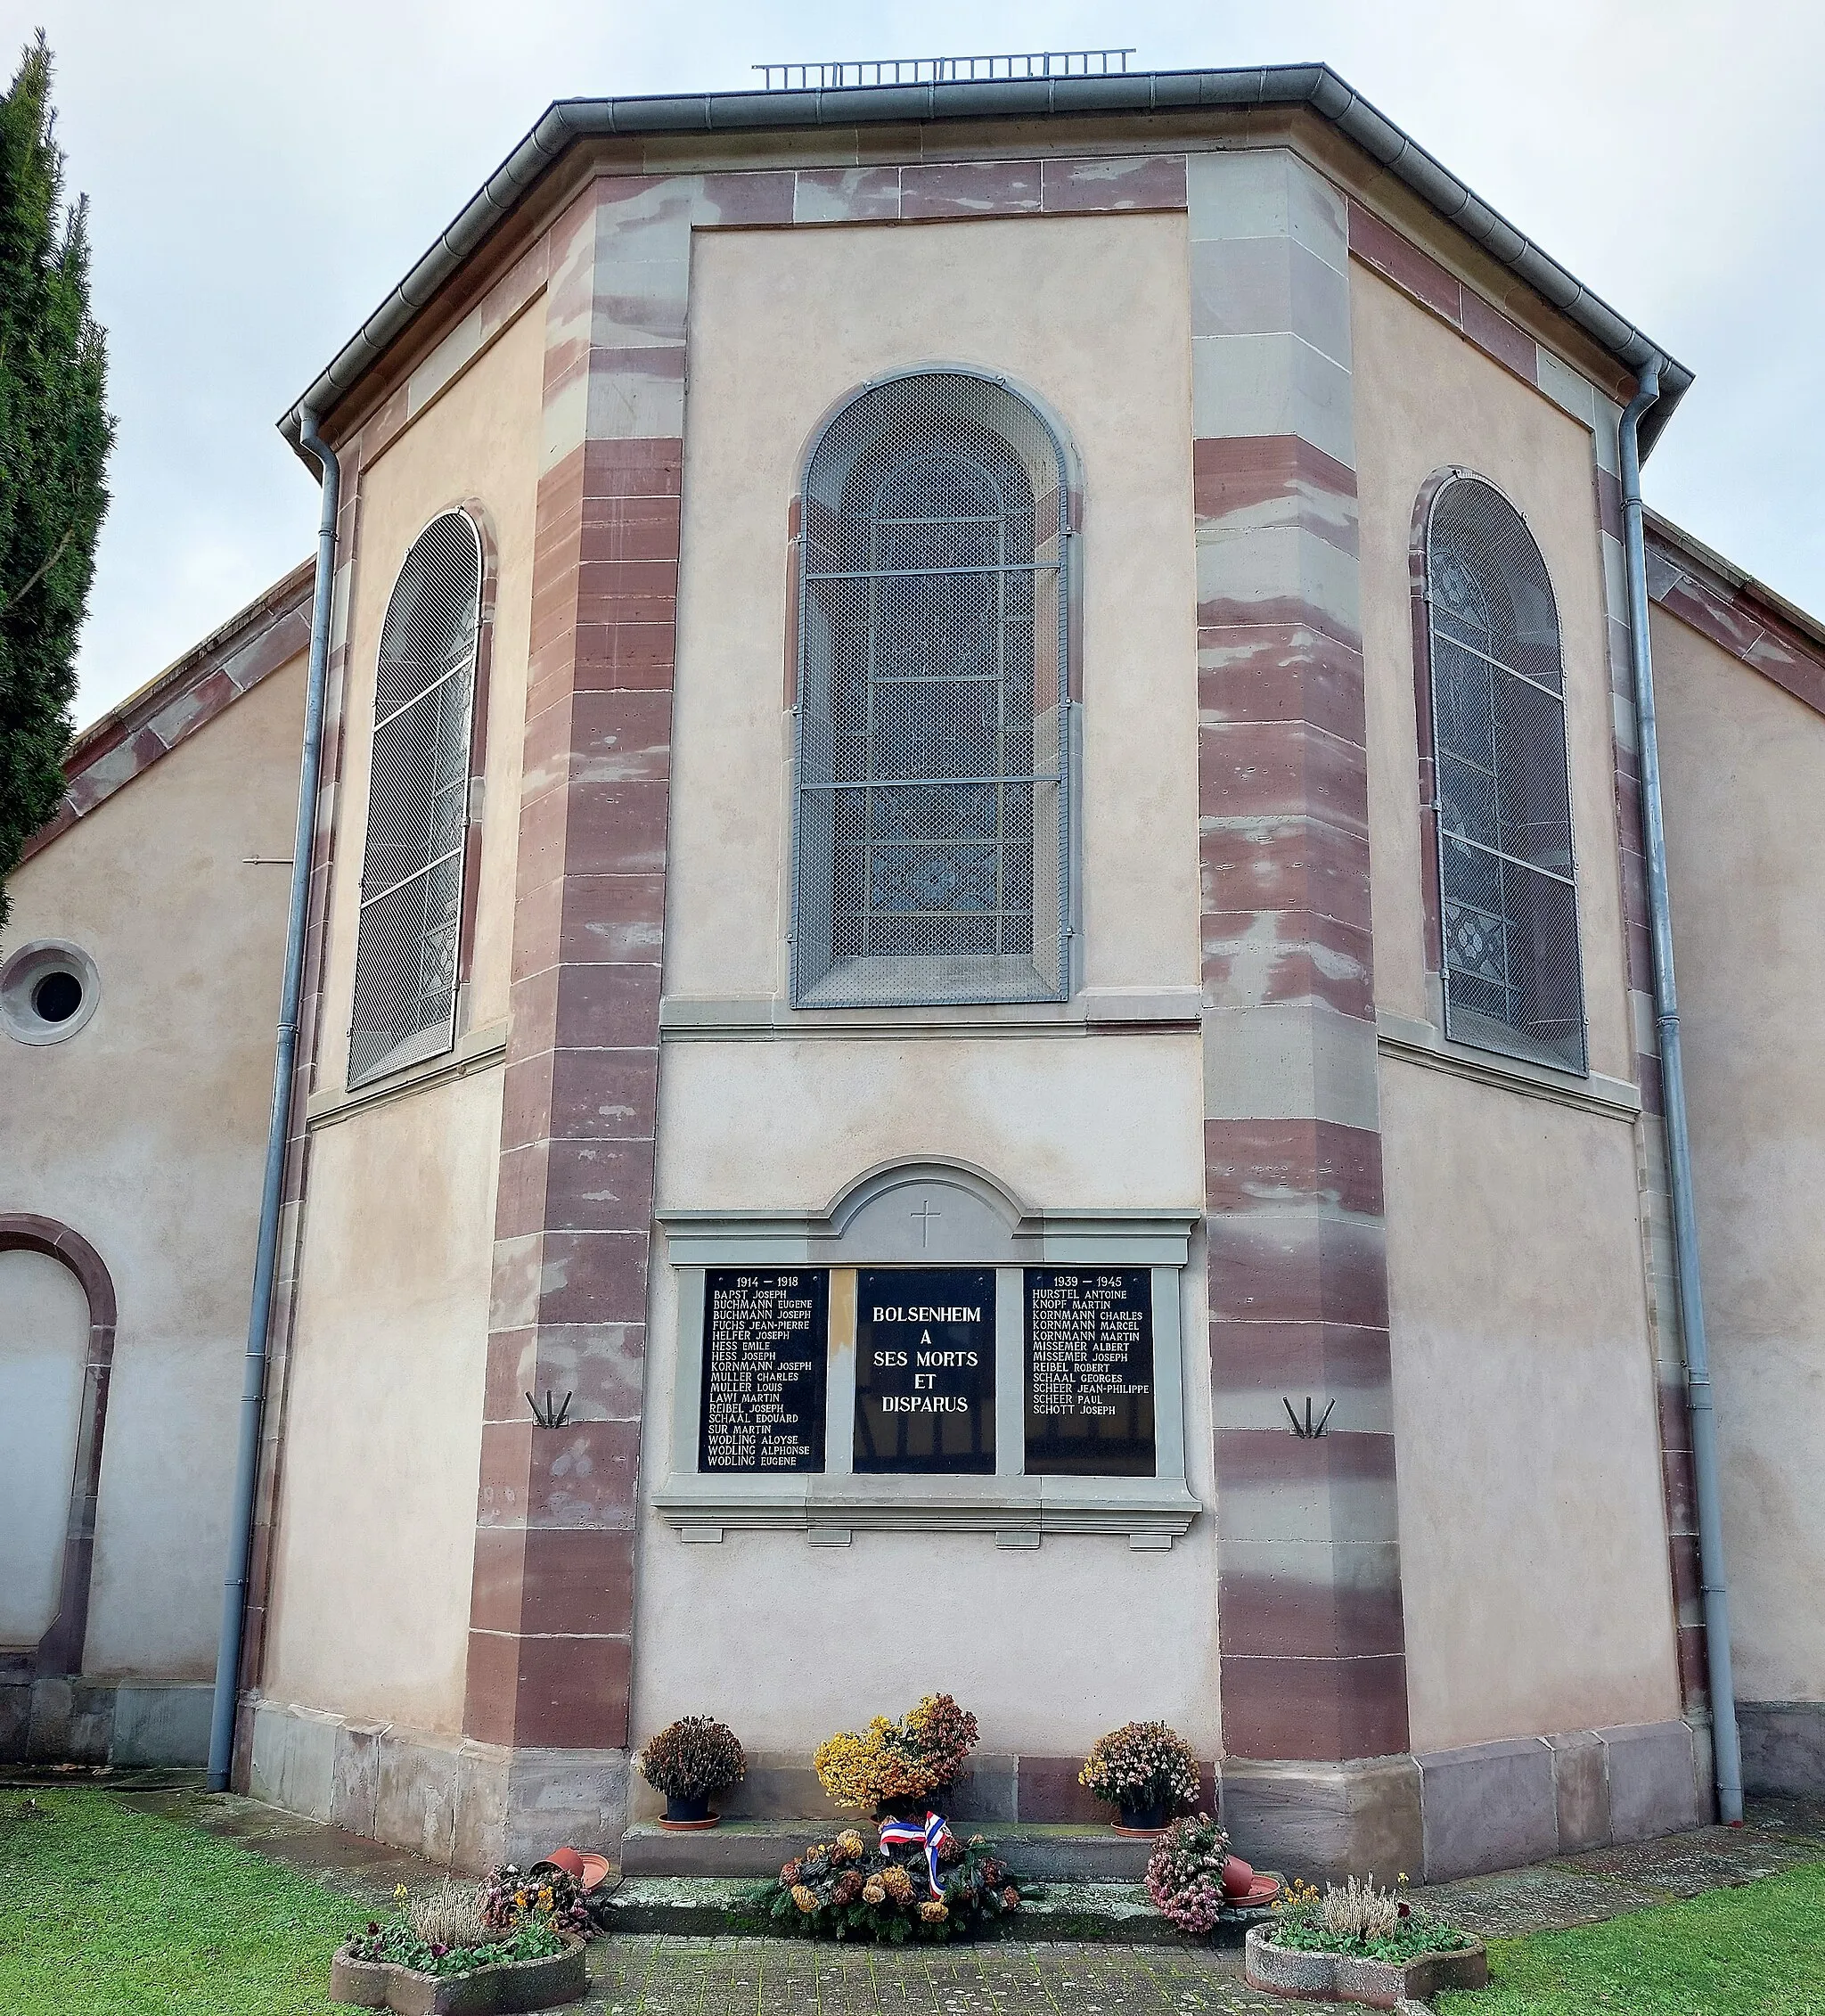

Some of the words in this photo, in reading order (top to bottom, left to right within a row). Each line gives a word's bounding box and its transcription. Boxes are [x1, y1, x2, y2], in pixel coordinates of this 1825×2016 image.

[737, 1276, 759, 1288] 1914
[777, 1276, 798, 1287] 1918
[1054, 1276, 1078, 1287] 1939
[1097, 1276, 1122, 1287] 1945
[714, 1290, 749, 1299] BAPST
[753, 1291, 787, 1299] JOSEPH
[1032, 1289, 1080, 1299] HURSTEL
[1084, 1290, 1127, 1299] ANTOINE
[713, 1299, 773, 1309] BUCHMANN
[778, 1300, 813, 1309] EUGENE
[1032, 1299, 1067, 1309] KNOPF
[1072, 1300, 1111, 1309] MARTIN
[713, 1310, 773, 1320] BUCHMANN
[777, 1310, 812, 1319] JOSEPH
[872, 1307, 981, 1323] BOLSENHEIM
[1032, 1310, 1095, 1320] KORNMANN
[1100, 1311, 1142, 1320] CHARLES
[713, 1321, 745, 1331] FUCHS
[749, 1321, 810, 1330] JEAN-PIERRE
[1032, 1320, 1095, 1331] KORNMANN
[1101, 1321, 1140, 1331] MARCEL
[712, 1331, 751, 1340] HELFER
[756, 1332, 790, 1340] JOSEPH
[921, 1329, 931, 1345] A
[1032, 1331, 1095, 1341] KORNMANN
[1101, 1332, 1140, 1341] MARTIN
[712, 1341, 738, 1351] HESS
[742, 1341, 771, 1350] EMILE
[1033, 1341, 1087, 1351] MISSEMER
[1093, 1342, 1130, 1352] ALBERT
[711, 1352, 737, 1361] HESS
[741, 1352, 776, 1361] JOSEPH
[873, 1351, 908, 1367] SES
[916, 1351, 978, 1367] MORTS
[1033, 1352, 1087, 1362] MISSEMER
[1093, 1353, 1128, 1362] JOSEPH
[711, 1362, 773, 1372] KORNMANN
[777, 1362, 812, 1371] JOSEPH
[1033, 1363, 1068, 1372] REIBEL
[1074, 1363, 1110, 1373] ROBERT
[710, 1373, 752, 1382] MULLER
[757, 1373, 799, 1381] CHARLES
[914, 1373, 937, 1389] ET
[1033, 1373, 1076, 1382] SCHAAL
[1080, 1373, 1123, 1382] GEORGES
[710, 1382, 752, 1392] MULLER
[757, 1383, 782, 1392] LOUIS
[1033, 1383, 1072, 1393] SCHEER
[1077, 1384, 1150, 1394] JEAN-PHILIPPE
[709, 1393, 737, 1403] LAWI
[741, 1393, 780, 1403] MARTIN
[1033, 1394, 1072, 1404] SCHEER
[1077, 1395, 1103, 1404] PAUL
[709, 1404, 745, 1414] REIBEL
[749, 1404, 784, 1414] JOSEPH
[882, 1396, 969, 1413] DISPARUS
[1033, 1405, 1076, 1414] SCHOTT
[1080, 1405, 1117, 1415] JOSEPH
[708, 1414, 751, 1423] SCHAAL
[756, 1414, 798, 1423] EDOUARD
[708, 1424, 728, 1434] SUR
[733, 1425, 772, 1434] MARTIN
[708, 1435, 757, 1445] WODLING
[761, 1436, 798, 1445] ALOYSE
[708, 1446, 756, 1455] WODLING
[761, 1446, 810, 1455] ALPHONSE
[708, 1455, 756, 1466] WODLING
[760, 1456, 797, 1466] EUGENE
